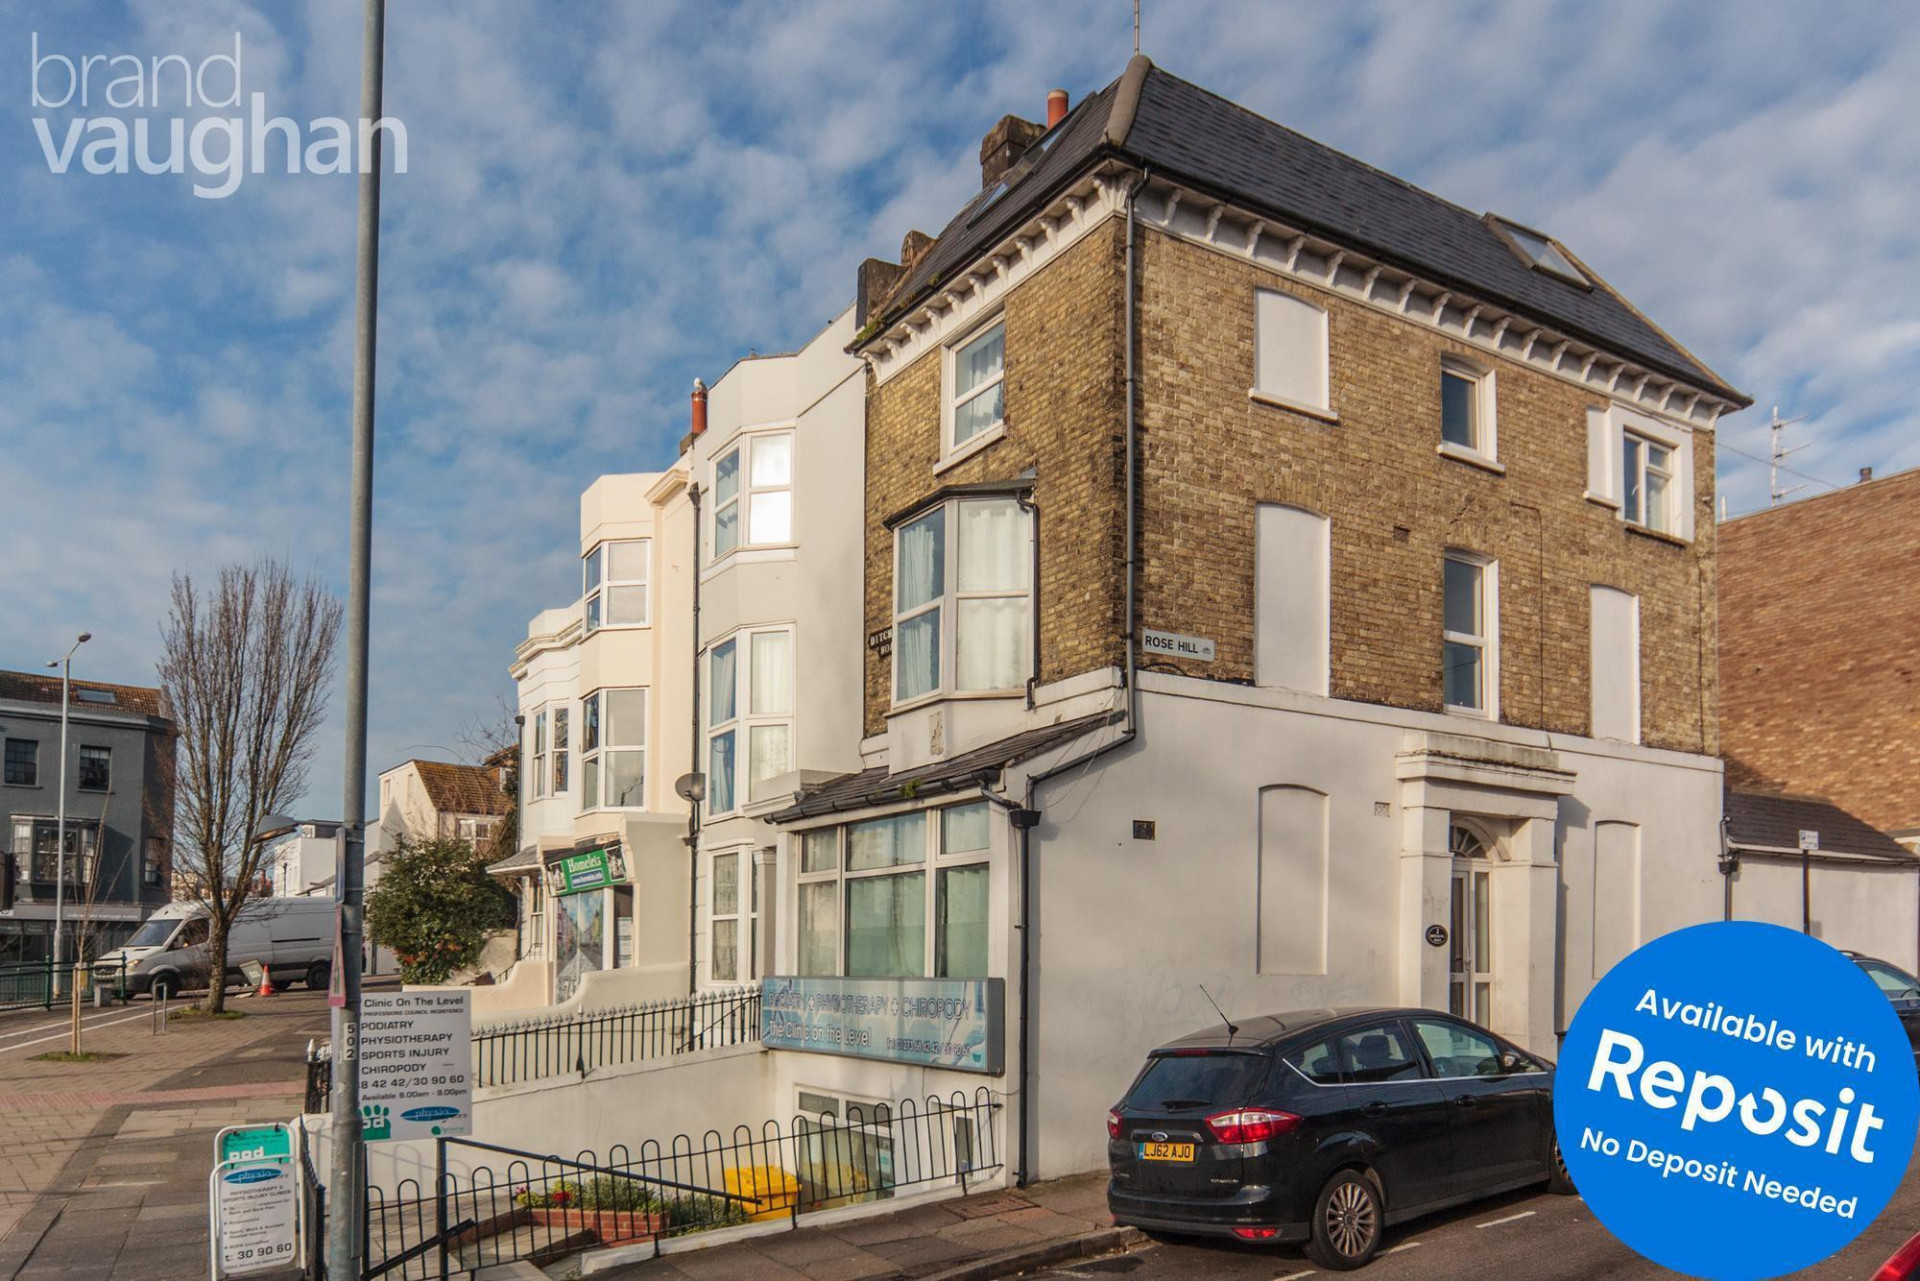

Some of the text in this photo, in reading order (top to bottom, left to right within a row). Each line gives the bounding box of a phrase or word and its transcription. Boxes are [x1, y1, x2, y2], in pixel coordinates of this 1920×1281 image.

[1145, 635, 1198, 653] ROSE HILL
[364, 996, 463, 1008] Clinic On The Level
[902, 997, 969, 1020] CHIROPODY
[361, 1021, 414, 1031] PODIATRY
[361, 1033, 453, 1046] PHYSIOTHERAPY
[769, 1020, 784, 1037] The
[786, 1021, 810, 1041] Clinic
[812, 1027, 823, 1041] on
[845, 1026, 872, 1047] Level
[361, 1048, 450, 1060] SPORTS INJURY
[362, 1063, 427, 1075] CHIROPODY
[371, 1080, 387, 1089] 42
[431, 1076, 446, 1085] 90
[449, 1075, 464, 1084] 60
[1144, 1143, 1191, 1158] LJ62 AJO
[237, 1249, 253, 1260] 30
[257, 1246, 273, 1256] 90
[277, 1242, 292, 1252] 60
